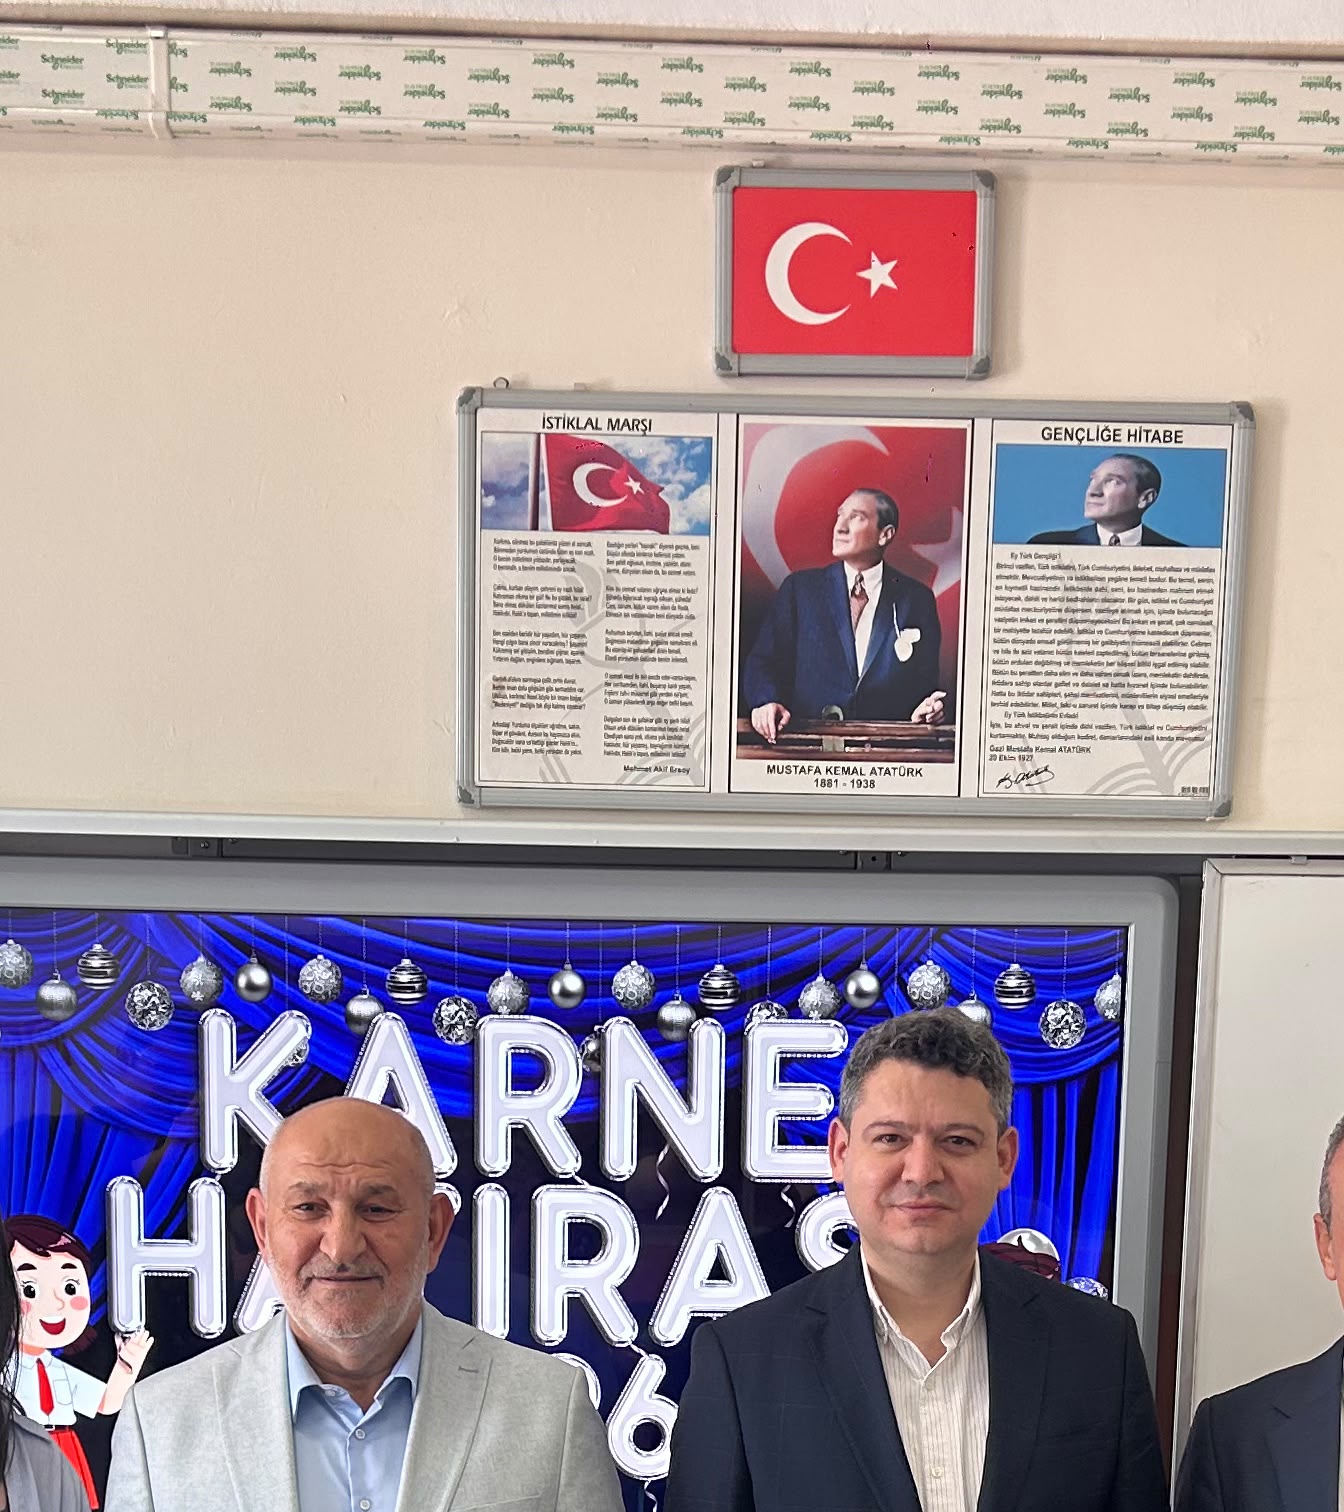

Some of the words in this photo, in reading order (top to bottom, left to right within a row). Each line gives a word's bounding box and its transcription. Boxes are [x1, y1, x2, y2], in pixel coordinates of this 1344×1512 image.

[542, 412, 602, 431] İSTİKLAL
[607, 418, 652, 436] MARŞI
[1041, 425, 1122, 445] GENÇLİĞE
[1127, 426, 1184, 444] HİTABE
[766, 764, 822, 775] MUSTAFA
[825, 765, 866, 776] KEMAL
[869, 766, 923, 777] ATATÜRK
[814, 778, 839, 788] 1881
[850, 779, 876, 789] 1938
[197, 1007, 849, 1184] KARNE
